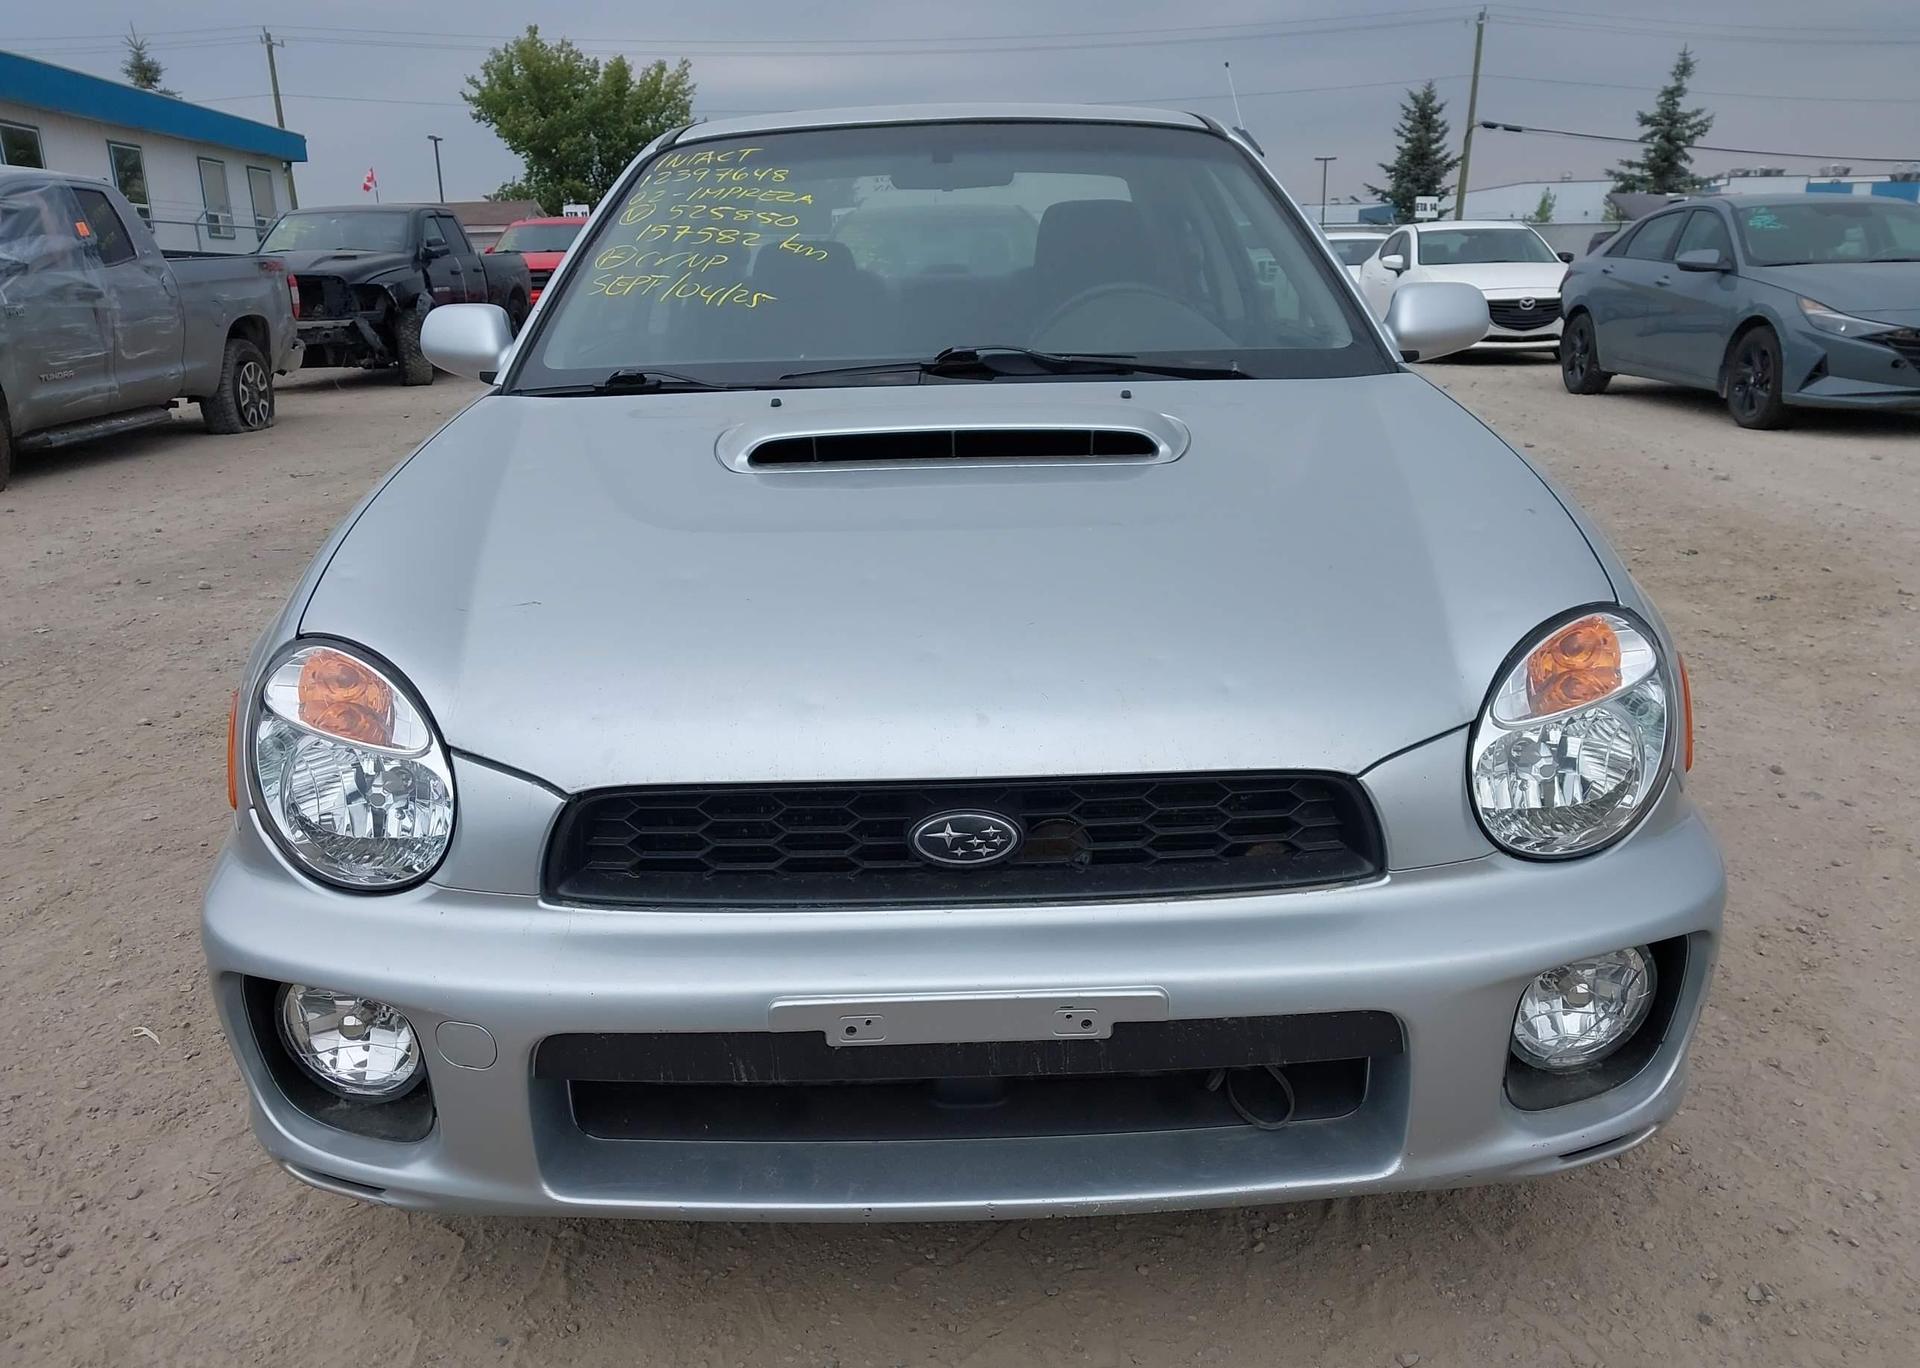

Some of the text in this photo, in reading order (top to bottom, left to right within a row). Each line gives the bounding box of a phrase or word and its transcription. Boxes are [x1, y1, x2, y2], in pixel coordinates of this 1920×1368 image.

[654, 148, 764, 171] INTACT
[640, 167, 790, 188] 12397648
[667, 205, 799, 227] 525850
[636, 224, 761, 246] 157582
